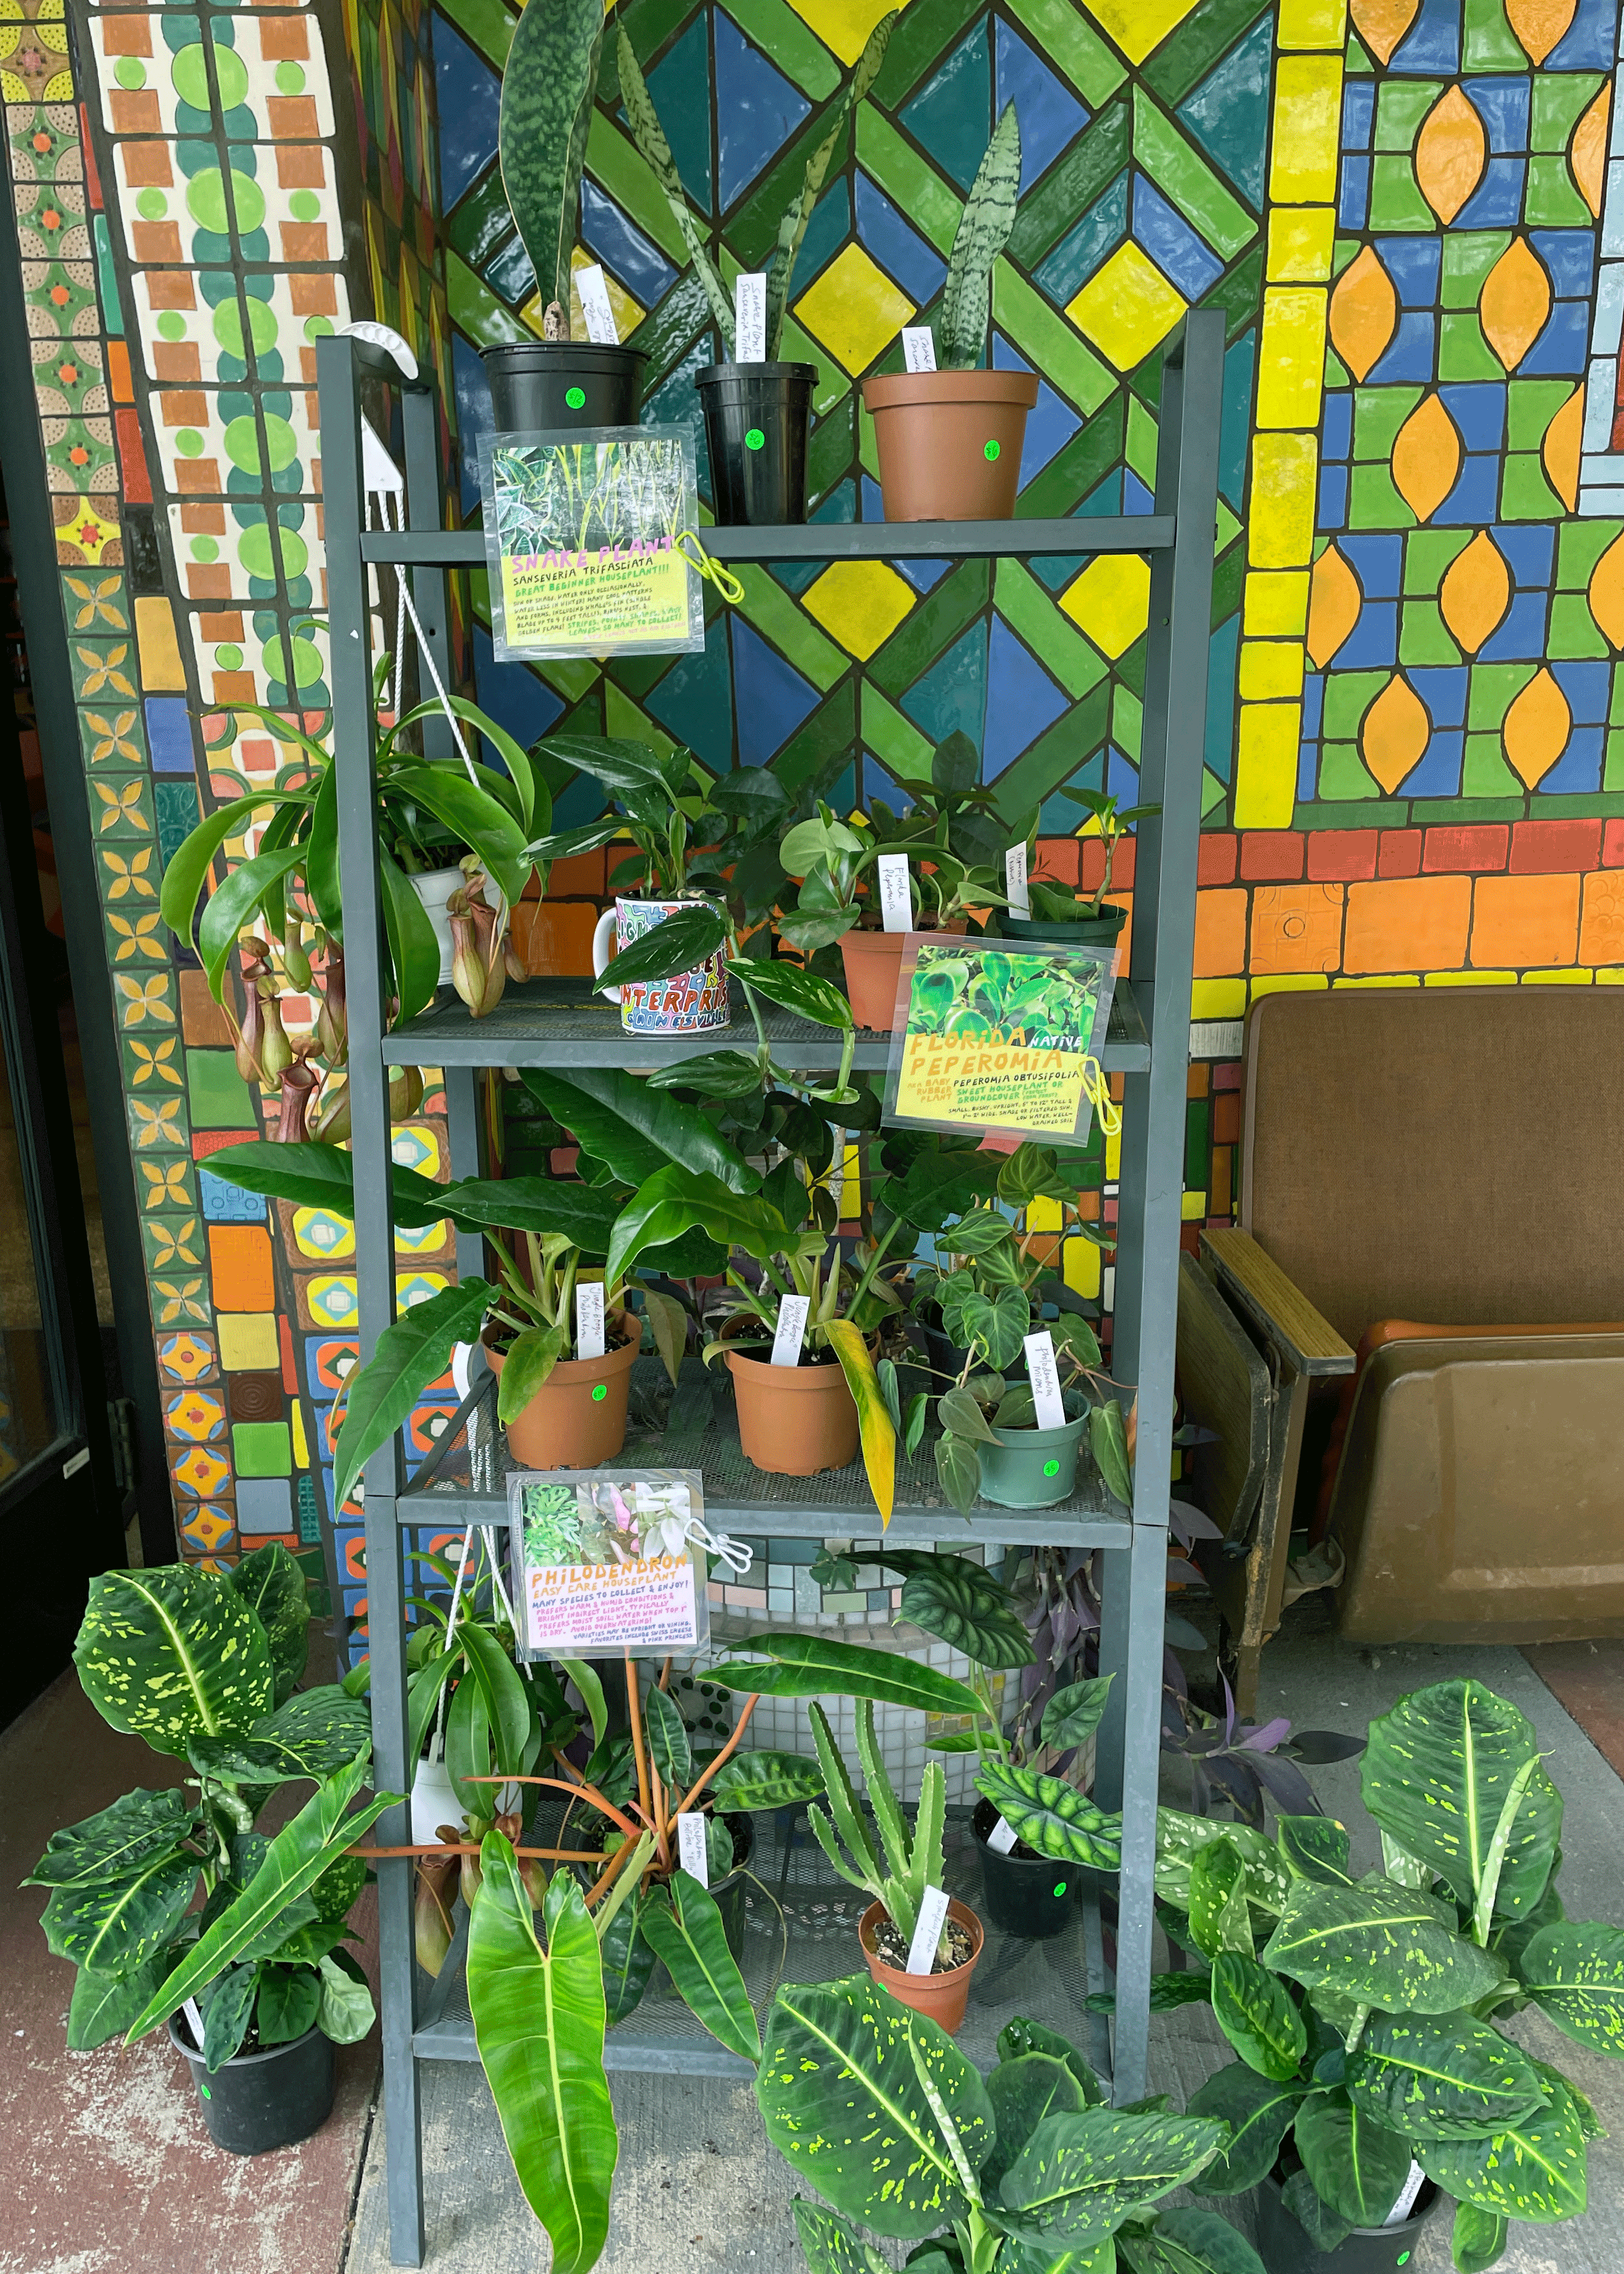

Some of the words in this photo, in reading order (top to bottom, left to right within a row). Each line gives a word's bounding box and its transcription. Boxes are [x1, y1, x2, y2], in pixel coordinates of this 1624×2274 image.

[751, 282, 761, 322] Snake
[751, 323, 763, 354] Plant
[512, 549, 588, 574] SNAKE
[599, 536, 675, 563] PLANT
[513, 568, 576, 586] SANSEVERIA
[583, 557, 653, 575] TRIFASCIATA
[515, 584, 545, 597] GREAT
[549, 577, 596, 591] BEGINNER
[599, 563, 669, 583] HOUSEPLANT!!!
[558, 592, 578, 600] WATER
[622, 587, 652, 596] PATTERNS
[552, 606, 584, 615] INCLUDING
[613, 599, 624, 607] FIN
[518, 628, 540, 636] GOLDEN
[601, 614, 626, 624] POINTY
[562, 614, 576, 623] FEET
[614, 620, 634, 628] MANY
[648, 613, 682, 625] COLLECT!
[883, 868, 895, 911] Peperomia
[894, 867, 907, 899] Florida
[910, 1026, 1027, 1056] FLORIDA
[1027, 1035, 1083, 1048] NATIVE
[910, 1048, 1062, 1076] PEPEROMIA
[925, 1078, 951, 1087] BABY
[953, 1074, 1010, 1087] PEPEROMIA
[1014, 1070, 1080, 1082] OBTUSIFOLIA
[917, 1085, 952, 1095] RUBBER
[920, 1093, 952, 1103] PLANT
[957, 1086, 986, 1096] SWEET
[989, 1081, 1048, 1092] HOUSEPLANT
[957, 1092, 1020, 1104] GROUNDCOVER
[532, 1552, 687, 1589] PHILODENDRON
[532, 1599, 556, 1609] MANY
[560, 1593, 594, 1605] SPECIES
[610, 1585, 646, 1597] COLLECT
[649, 1584, 654, 1592] &
[657, 1579, 688, 1592] ENJOY!
[534, 1586, 562, 1599] EASY
[568, 1582, 597, 1593] CARE
[603, 1571, 677, 1588] HOUSEPLANT
[537, 1605, 568, 1615] PREFERS
[570, 1602, 591, 1610] WARM
[600, 1598, 623, 1607] HUMID
[625, 1593, 667, 1604] CONDITIONS
[537, 1613, 565, 1622] BRIGHT
[567, 1608, 600, 1618] INDIRECT
[602, 1605, 628, 1614] LIGHT.
[629, 1600, 669, 1610] TYPICALLY
[539, 1620, 570, 1630] PREFERS
[572, 1617, 593, 1625] MOIST
[616, 1611, 641, 1619] WATER
[570, 1625, 592, 1633] AVOID
[594, 1617, 652, 1629] OVERWATERING!
[573, 1631, 605, 1639] VARIETIES
[630, 1624, 656, 1632] UPRIGHT
[590, 1635, 623, 1644] FAVORITES
[665, 1633, 693, 1641] PRINCESS
